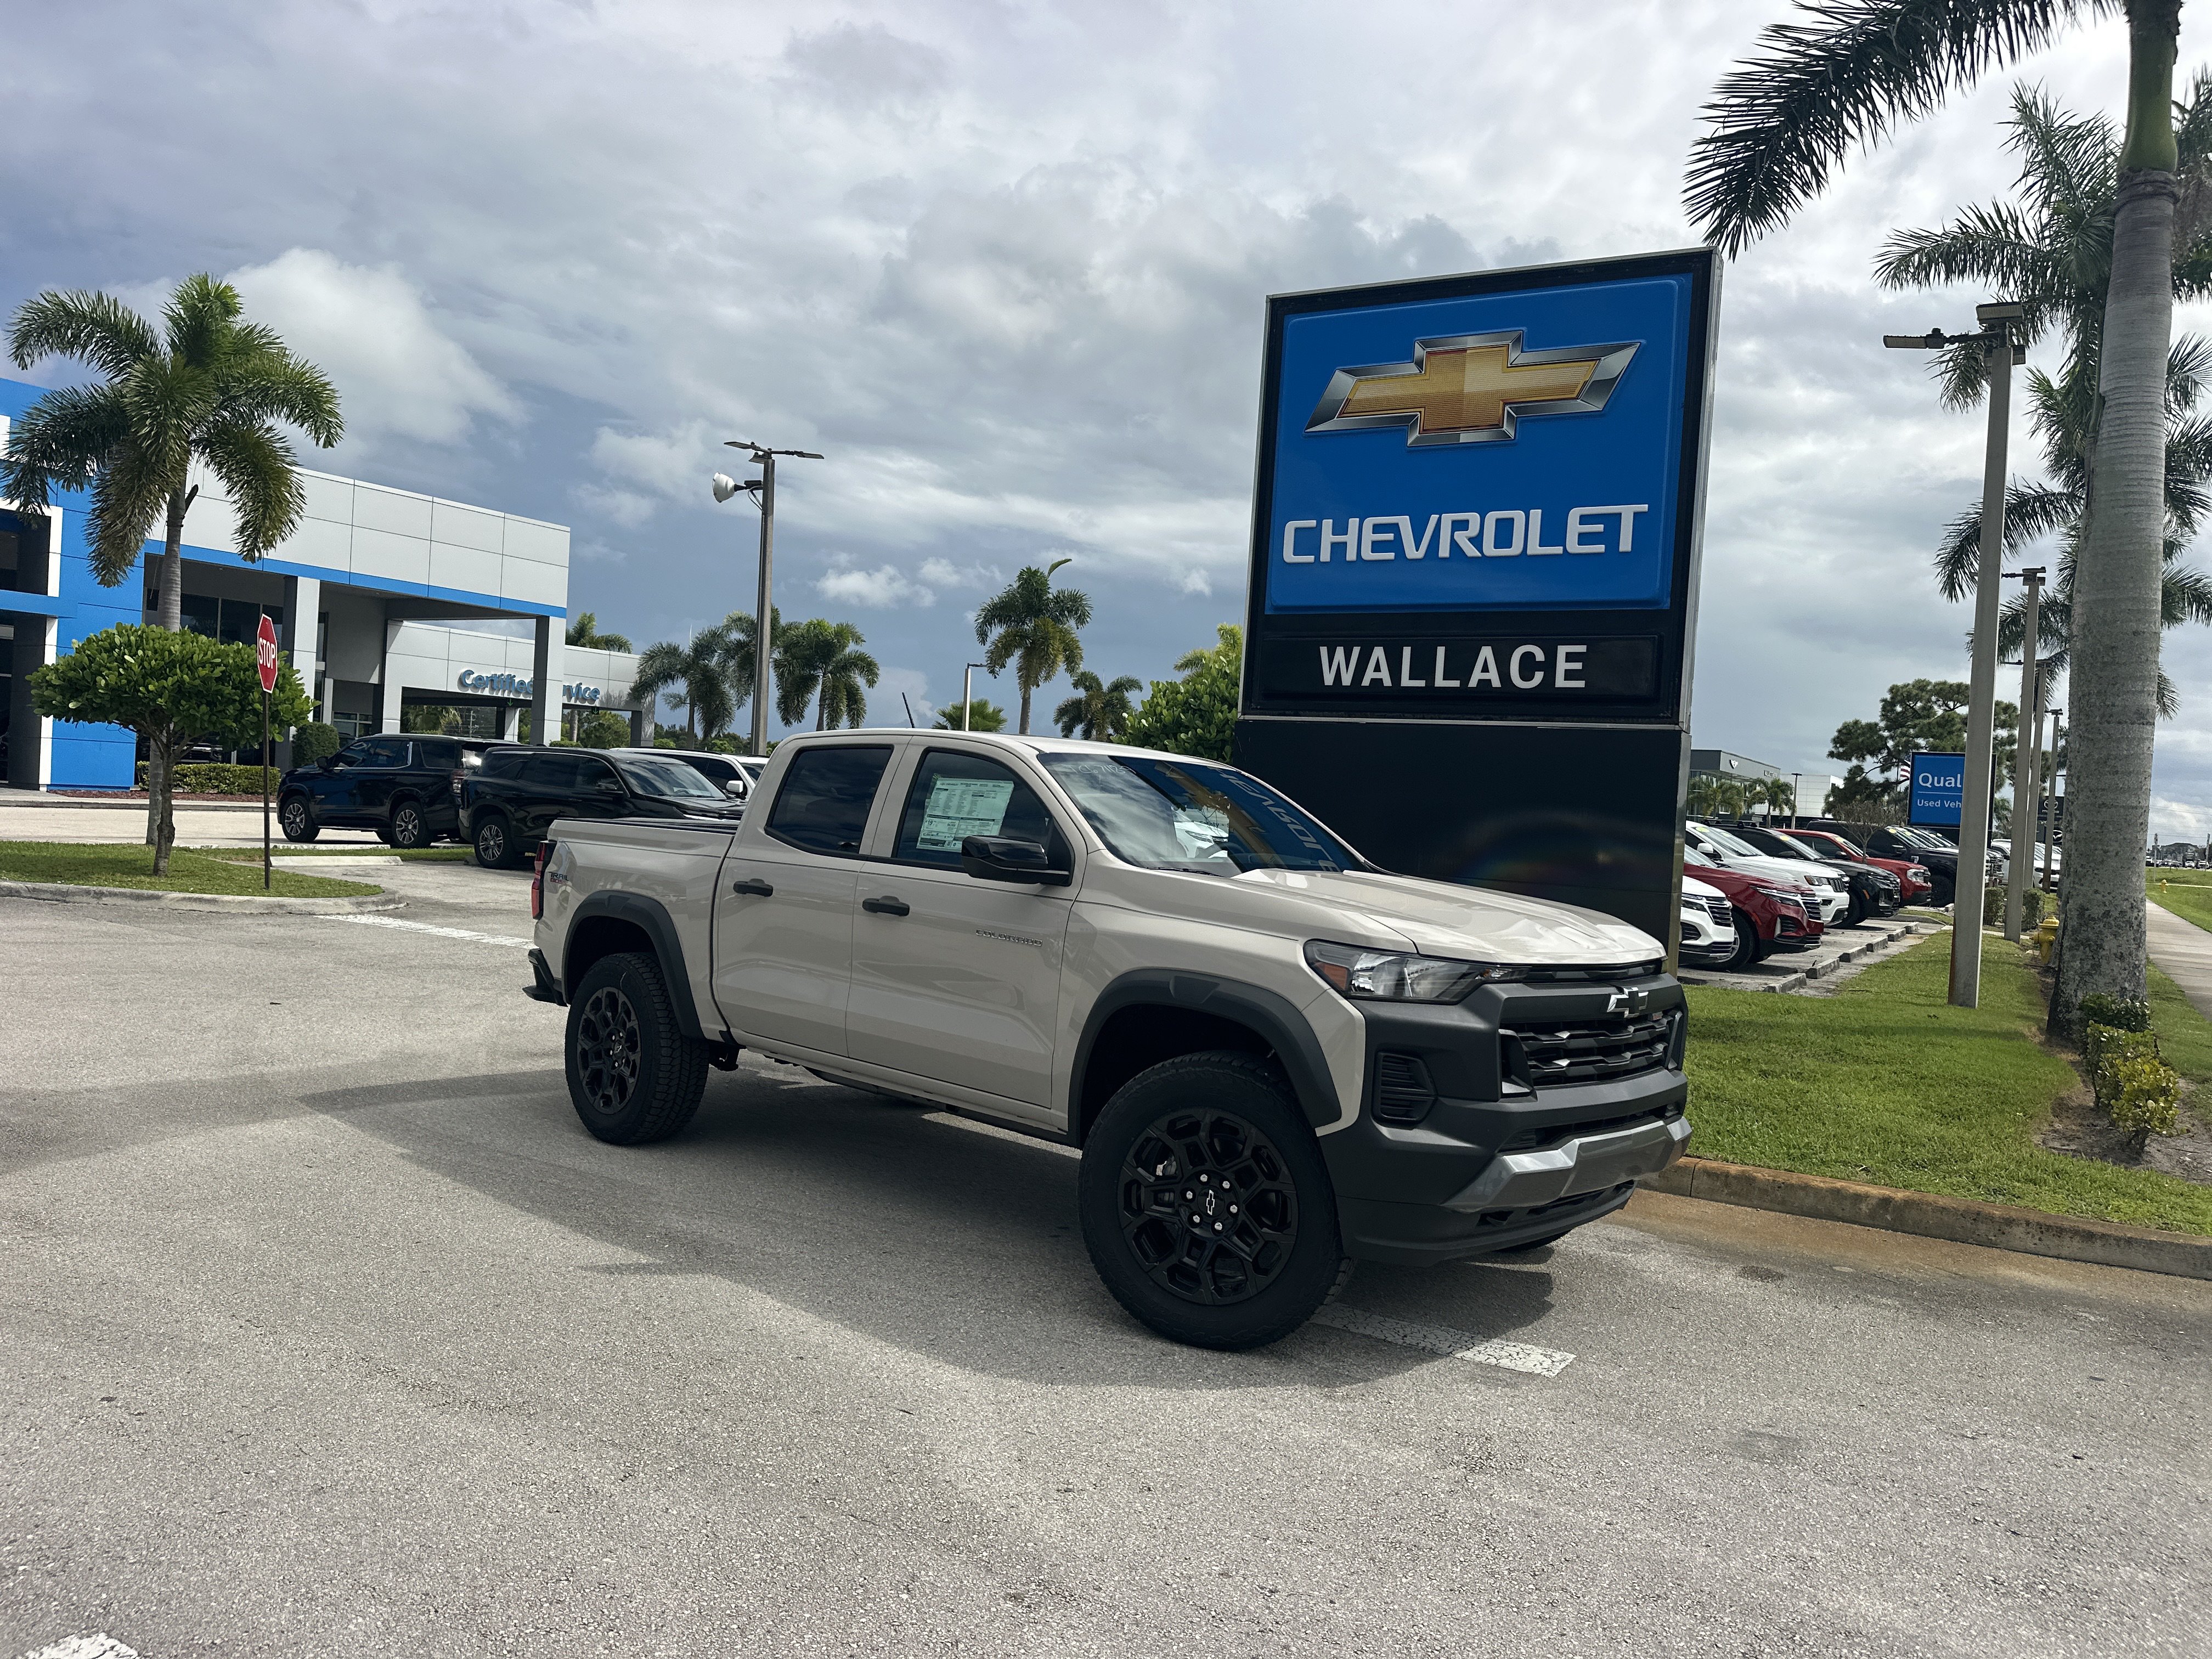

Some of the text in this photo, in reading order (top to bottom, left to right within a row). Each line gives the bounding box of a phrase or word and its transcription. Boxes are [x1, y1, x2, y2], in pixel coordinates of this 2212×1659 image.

[1283, 504, 1648, 563] CHEVROLET
[259, 637, 275, 669] STOP
[1319, 645, 1587, 688] WALLACE
[1918, 773, 1962, 788] Qual
[548, 871, 569, 881] TRAIL
[976, 929, 1042, 946] COLORADO
